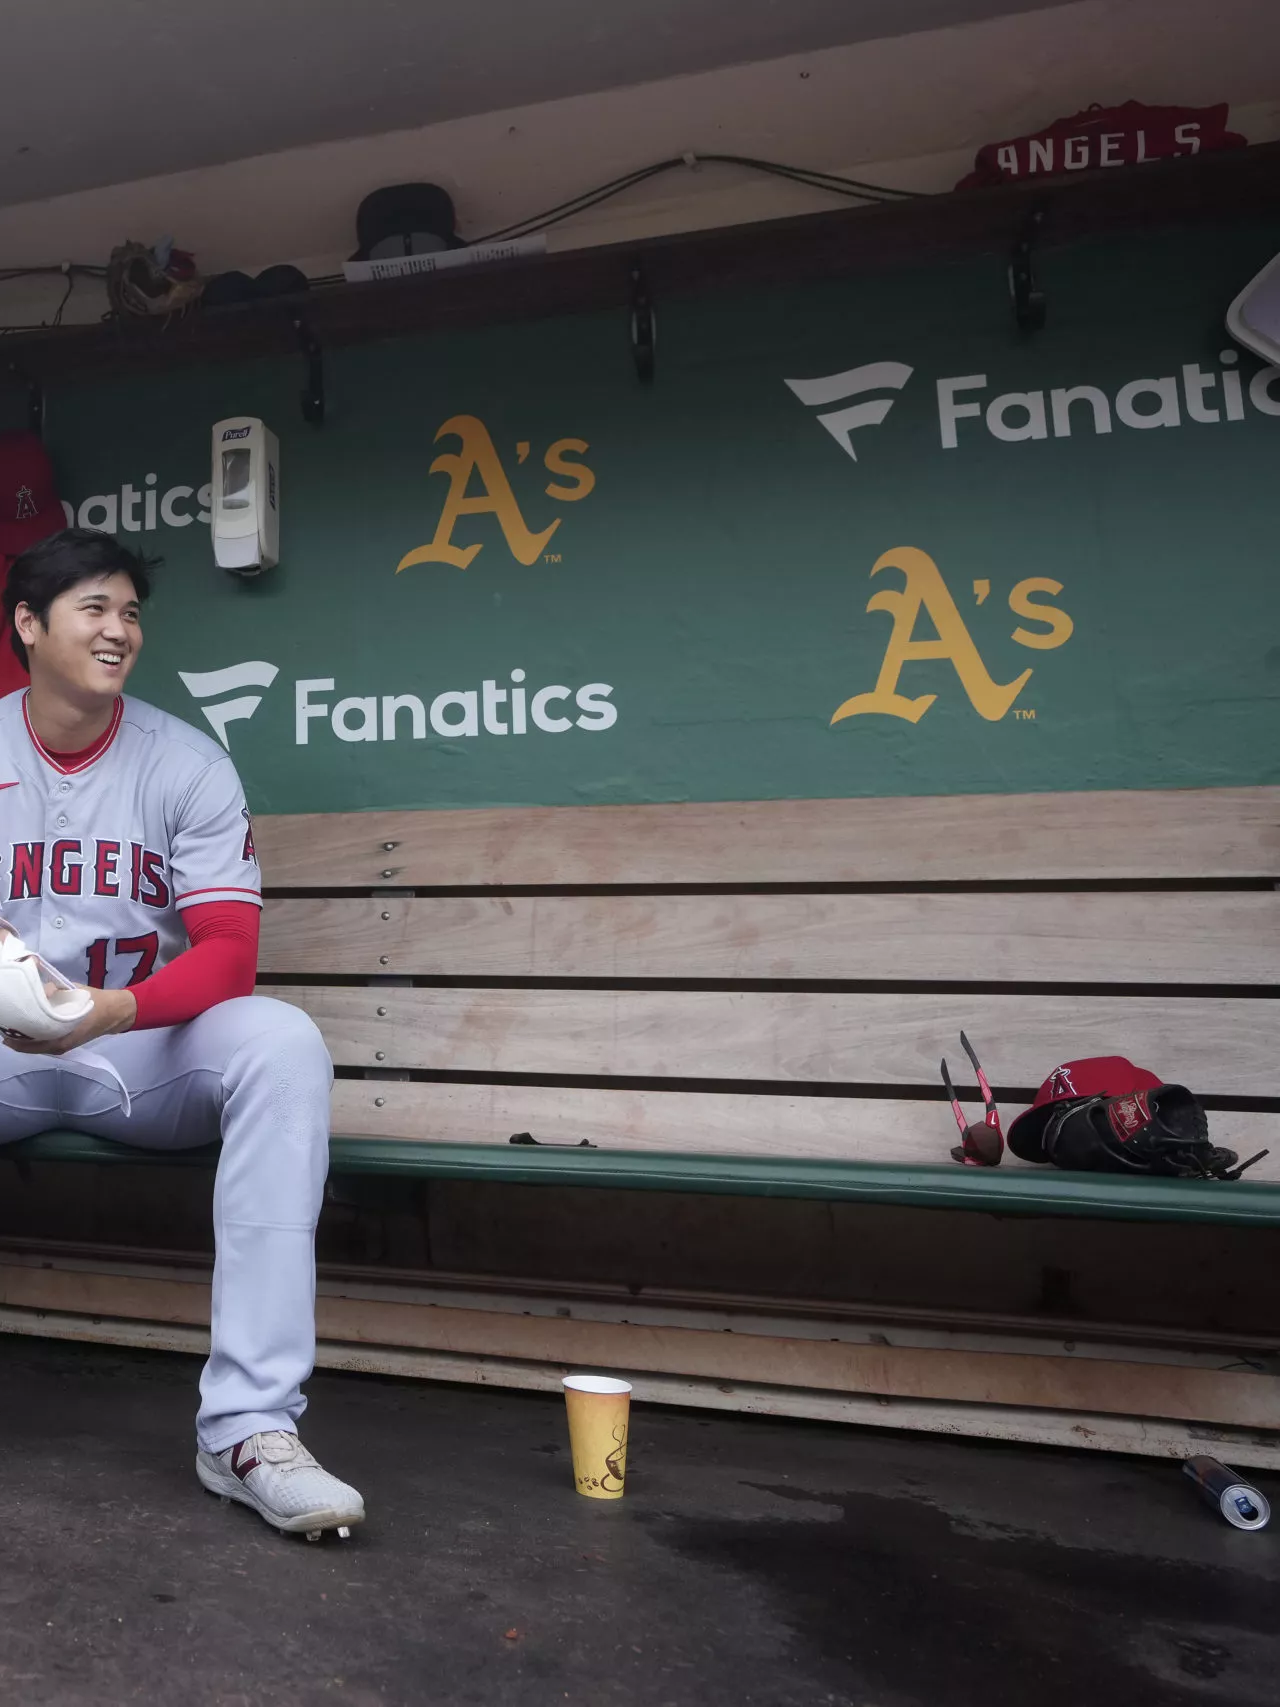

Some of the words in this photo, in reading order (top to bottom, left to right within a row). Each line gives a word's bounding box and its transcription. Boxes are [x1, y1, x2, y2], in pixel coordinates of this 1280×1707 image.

[996, 122, 1202, 176] ANGELS
[935, 348, 1280, 450] Fanatic
[394, 413, 597, 576] A's
[543, 553, 563, 564] TM
[829, 545, 1074, 726] A's
[295, 668, 618, 745] Fanatics
[1012, 709, 1037, 721] TM
[85, 930, 160, 990] 17
